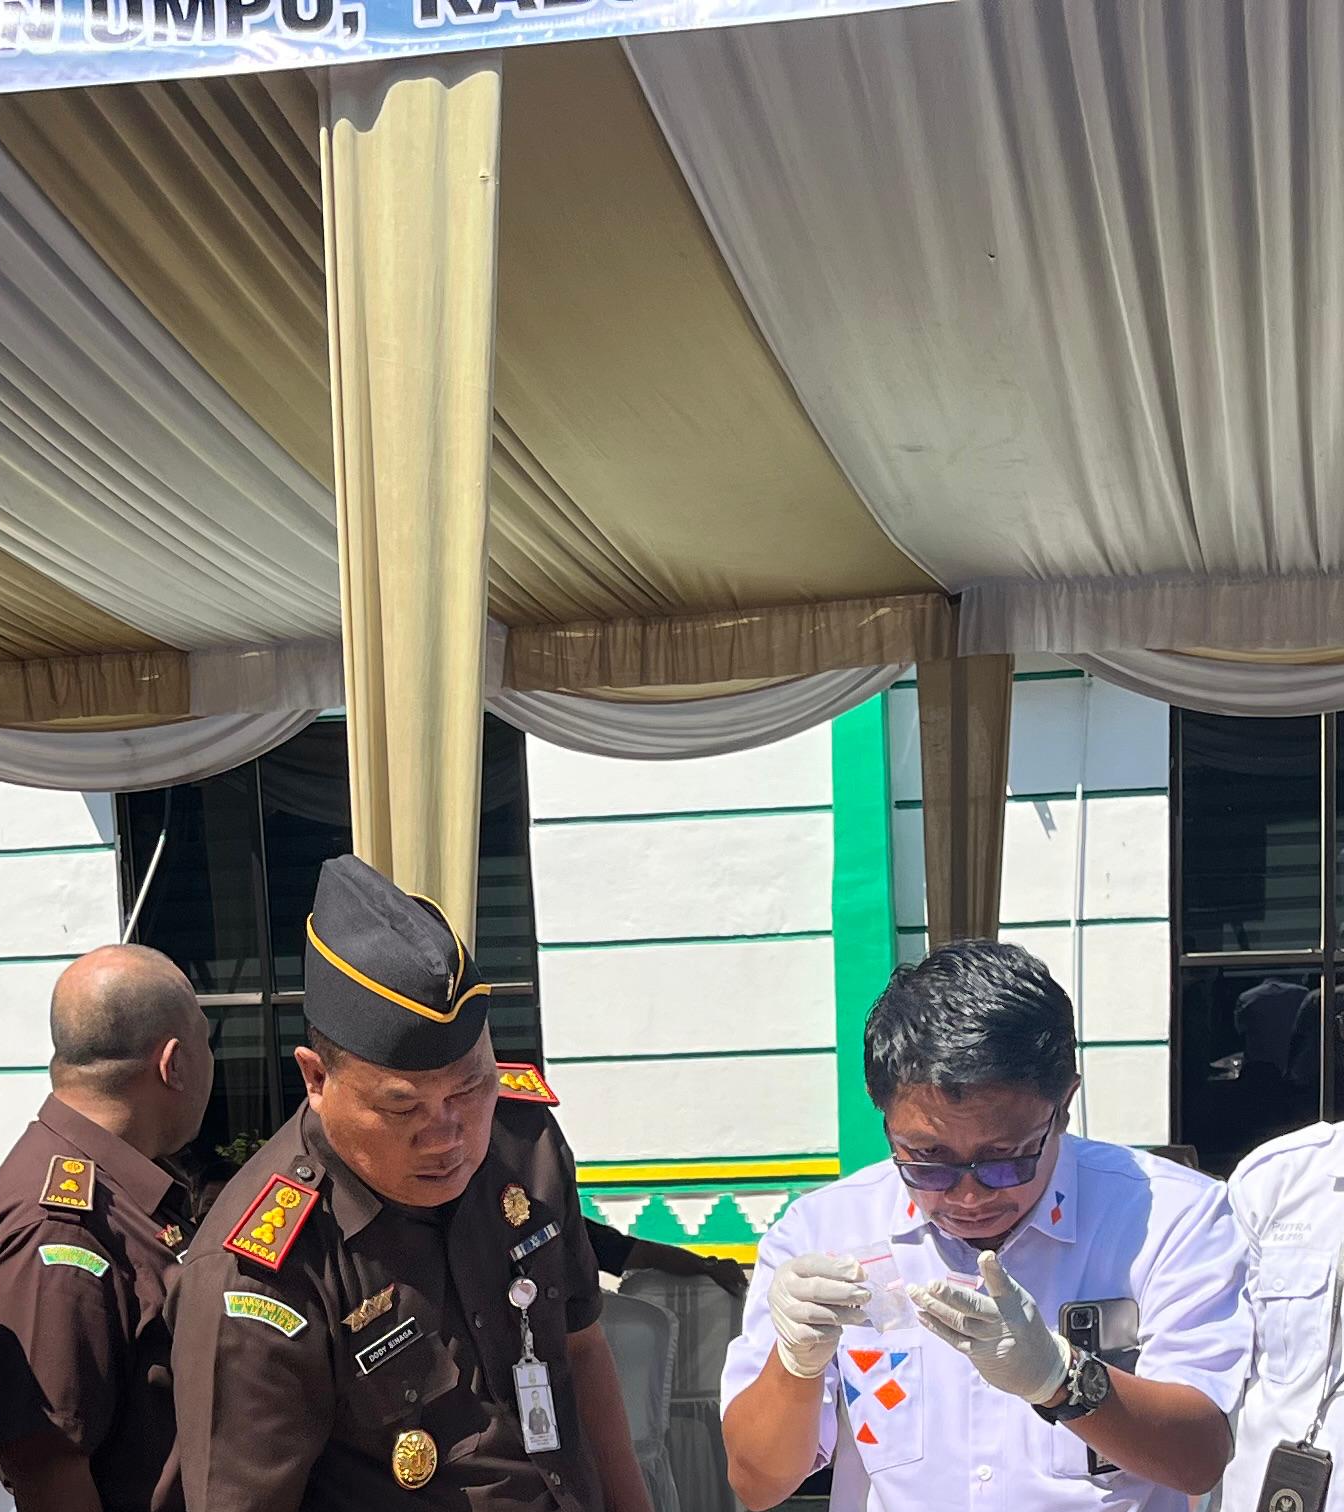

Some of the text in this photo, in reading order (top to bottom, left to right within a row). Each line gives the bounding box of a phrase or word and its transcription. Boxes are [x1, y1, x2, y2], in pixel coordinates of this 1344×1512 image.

[46, 1194, 87, 1207] JAKSA
[232, 1237, 277, 1263] JAKSA
[368, 1345, 387, 1363] DODY
